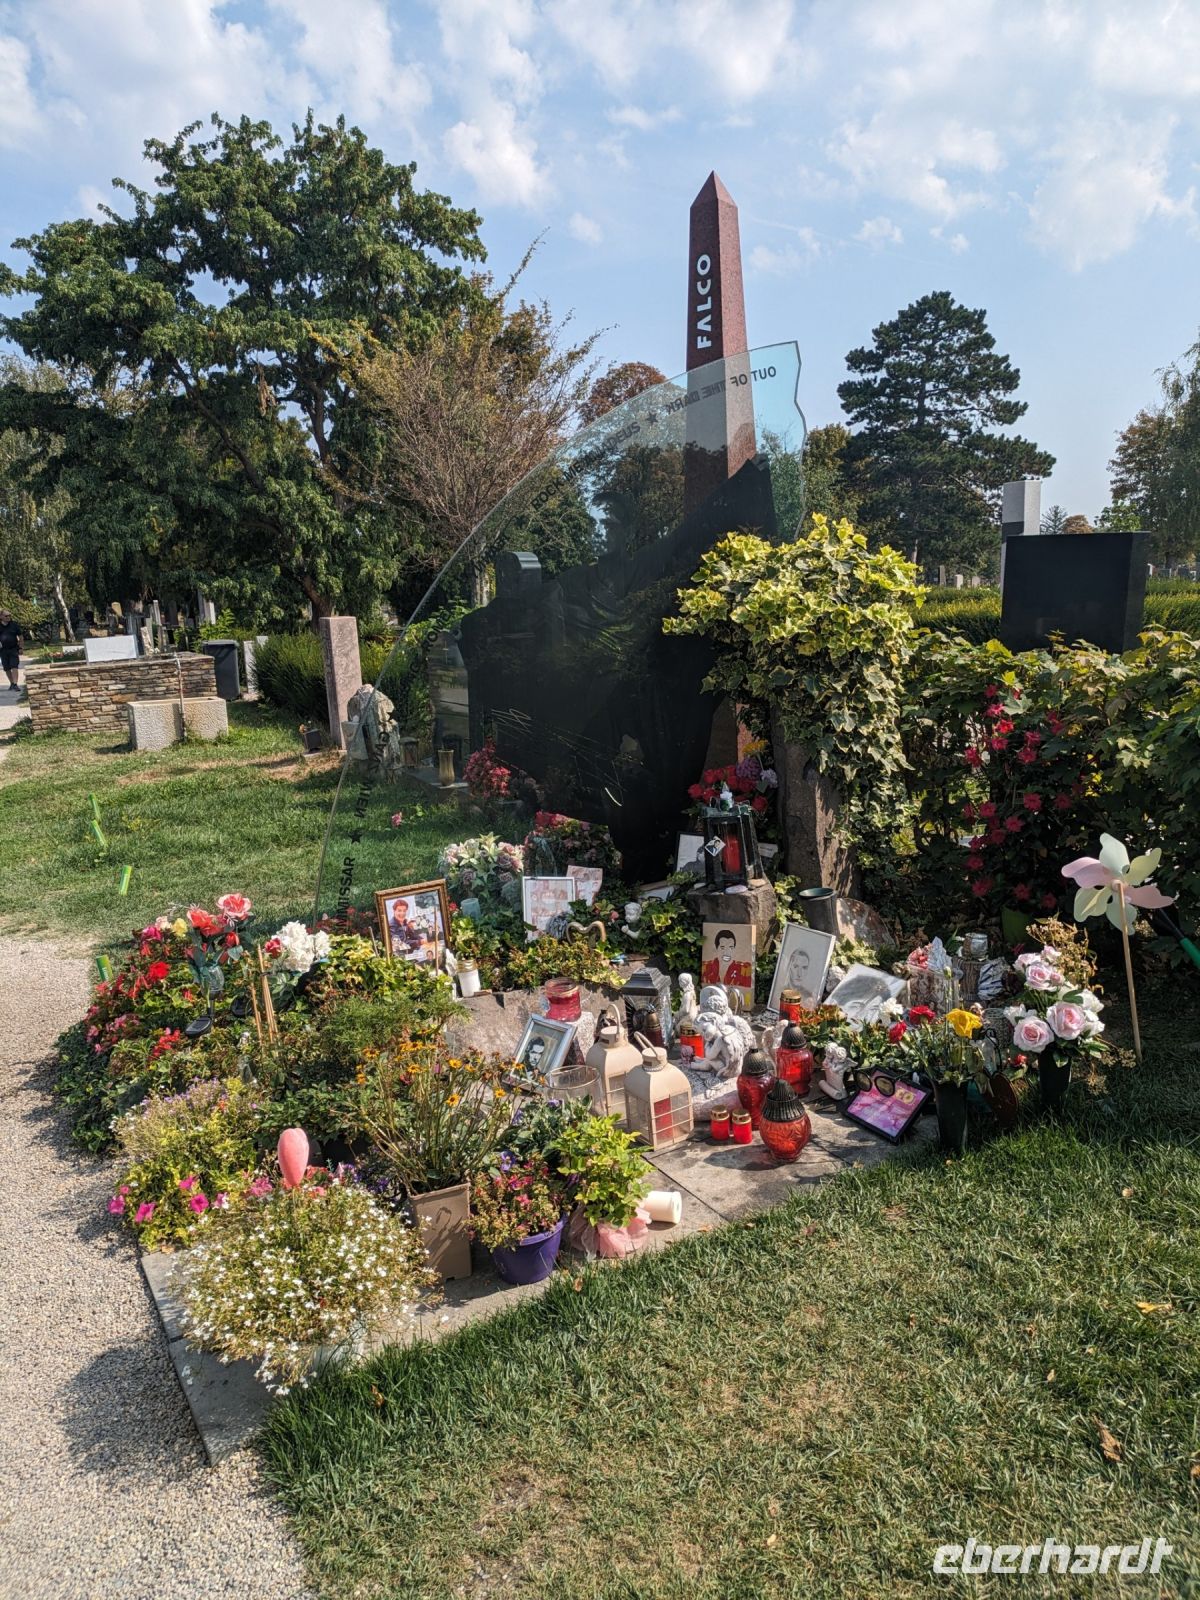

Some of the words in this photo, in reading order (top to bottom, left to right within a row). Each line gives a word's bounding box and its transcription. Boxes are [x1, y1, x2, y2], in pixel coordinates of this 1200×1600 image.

[696, 253, 712, 350] FALCO
[531, 480, 566, 511] ROCK
[562, 461, 584, 483] ME
